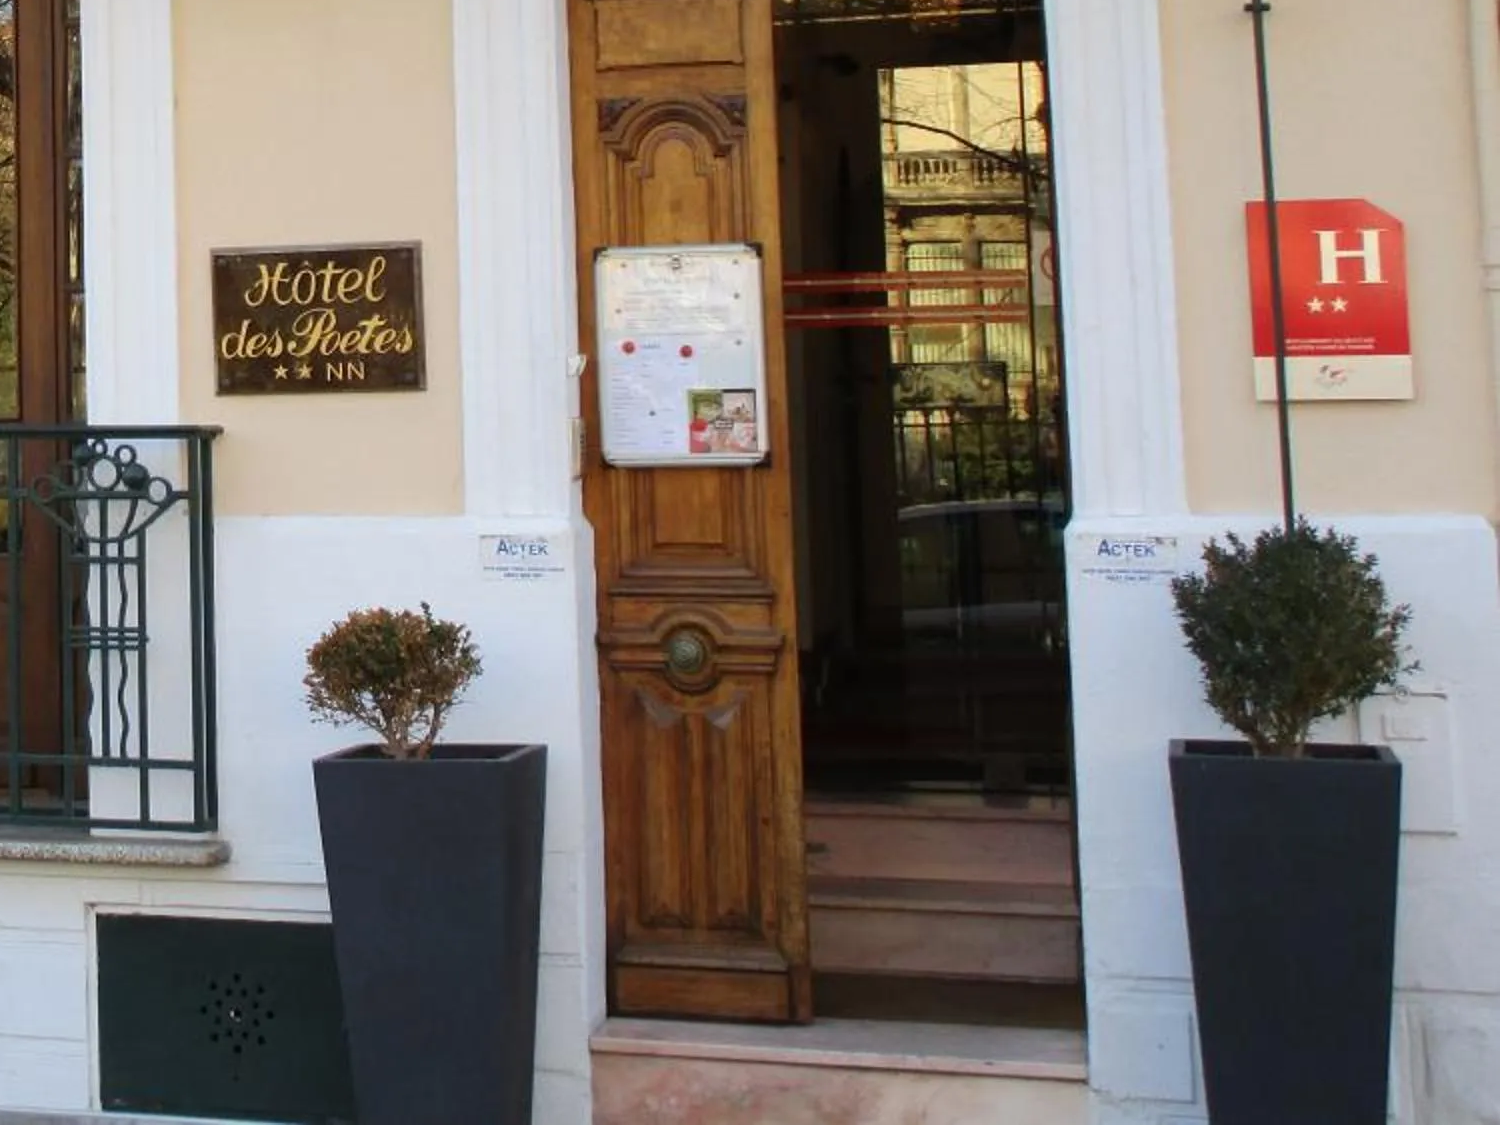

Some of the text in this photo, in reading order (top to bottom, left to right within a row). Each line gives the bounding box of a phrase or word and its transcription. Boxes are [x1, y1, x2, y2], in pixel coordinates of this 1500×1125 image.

[1312, 228, 1389, 284] H
[244, 256, 387, 306] Hôtel
[221, 319, 283, 359] des
[326, 362, 366, 381] NN
